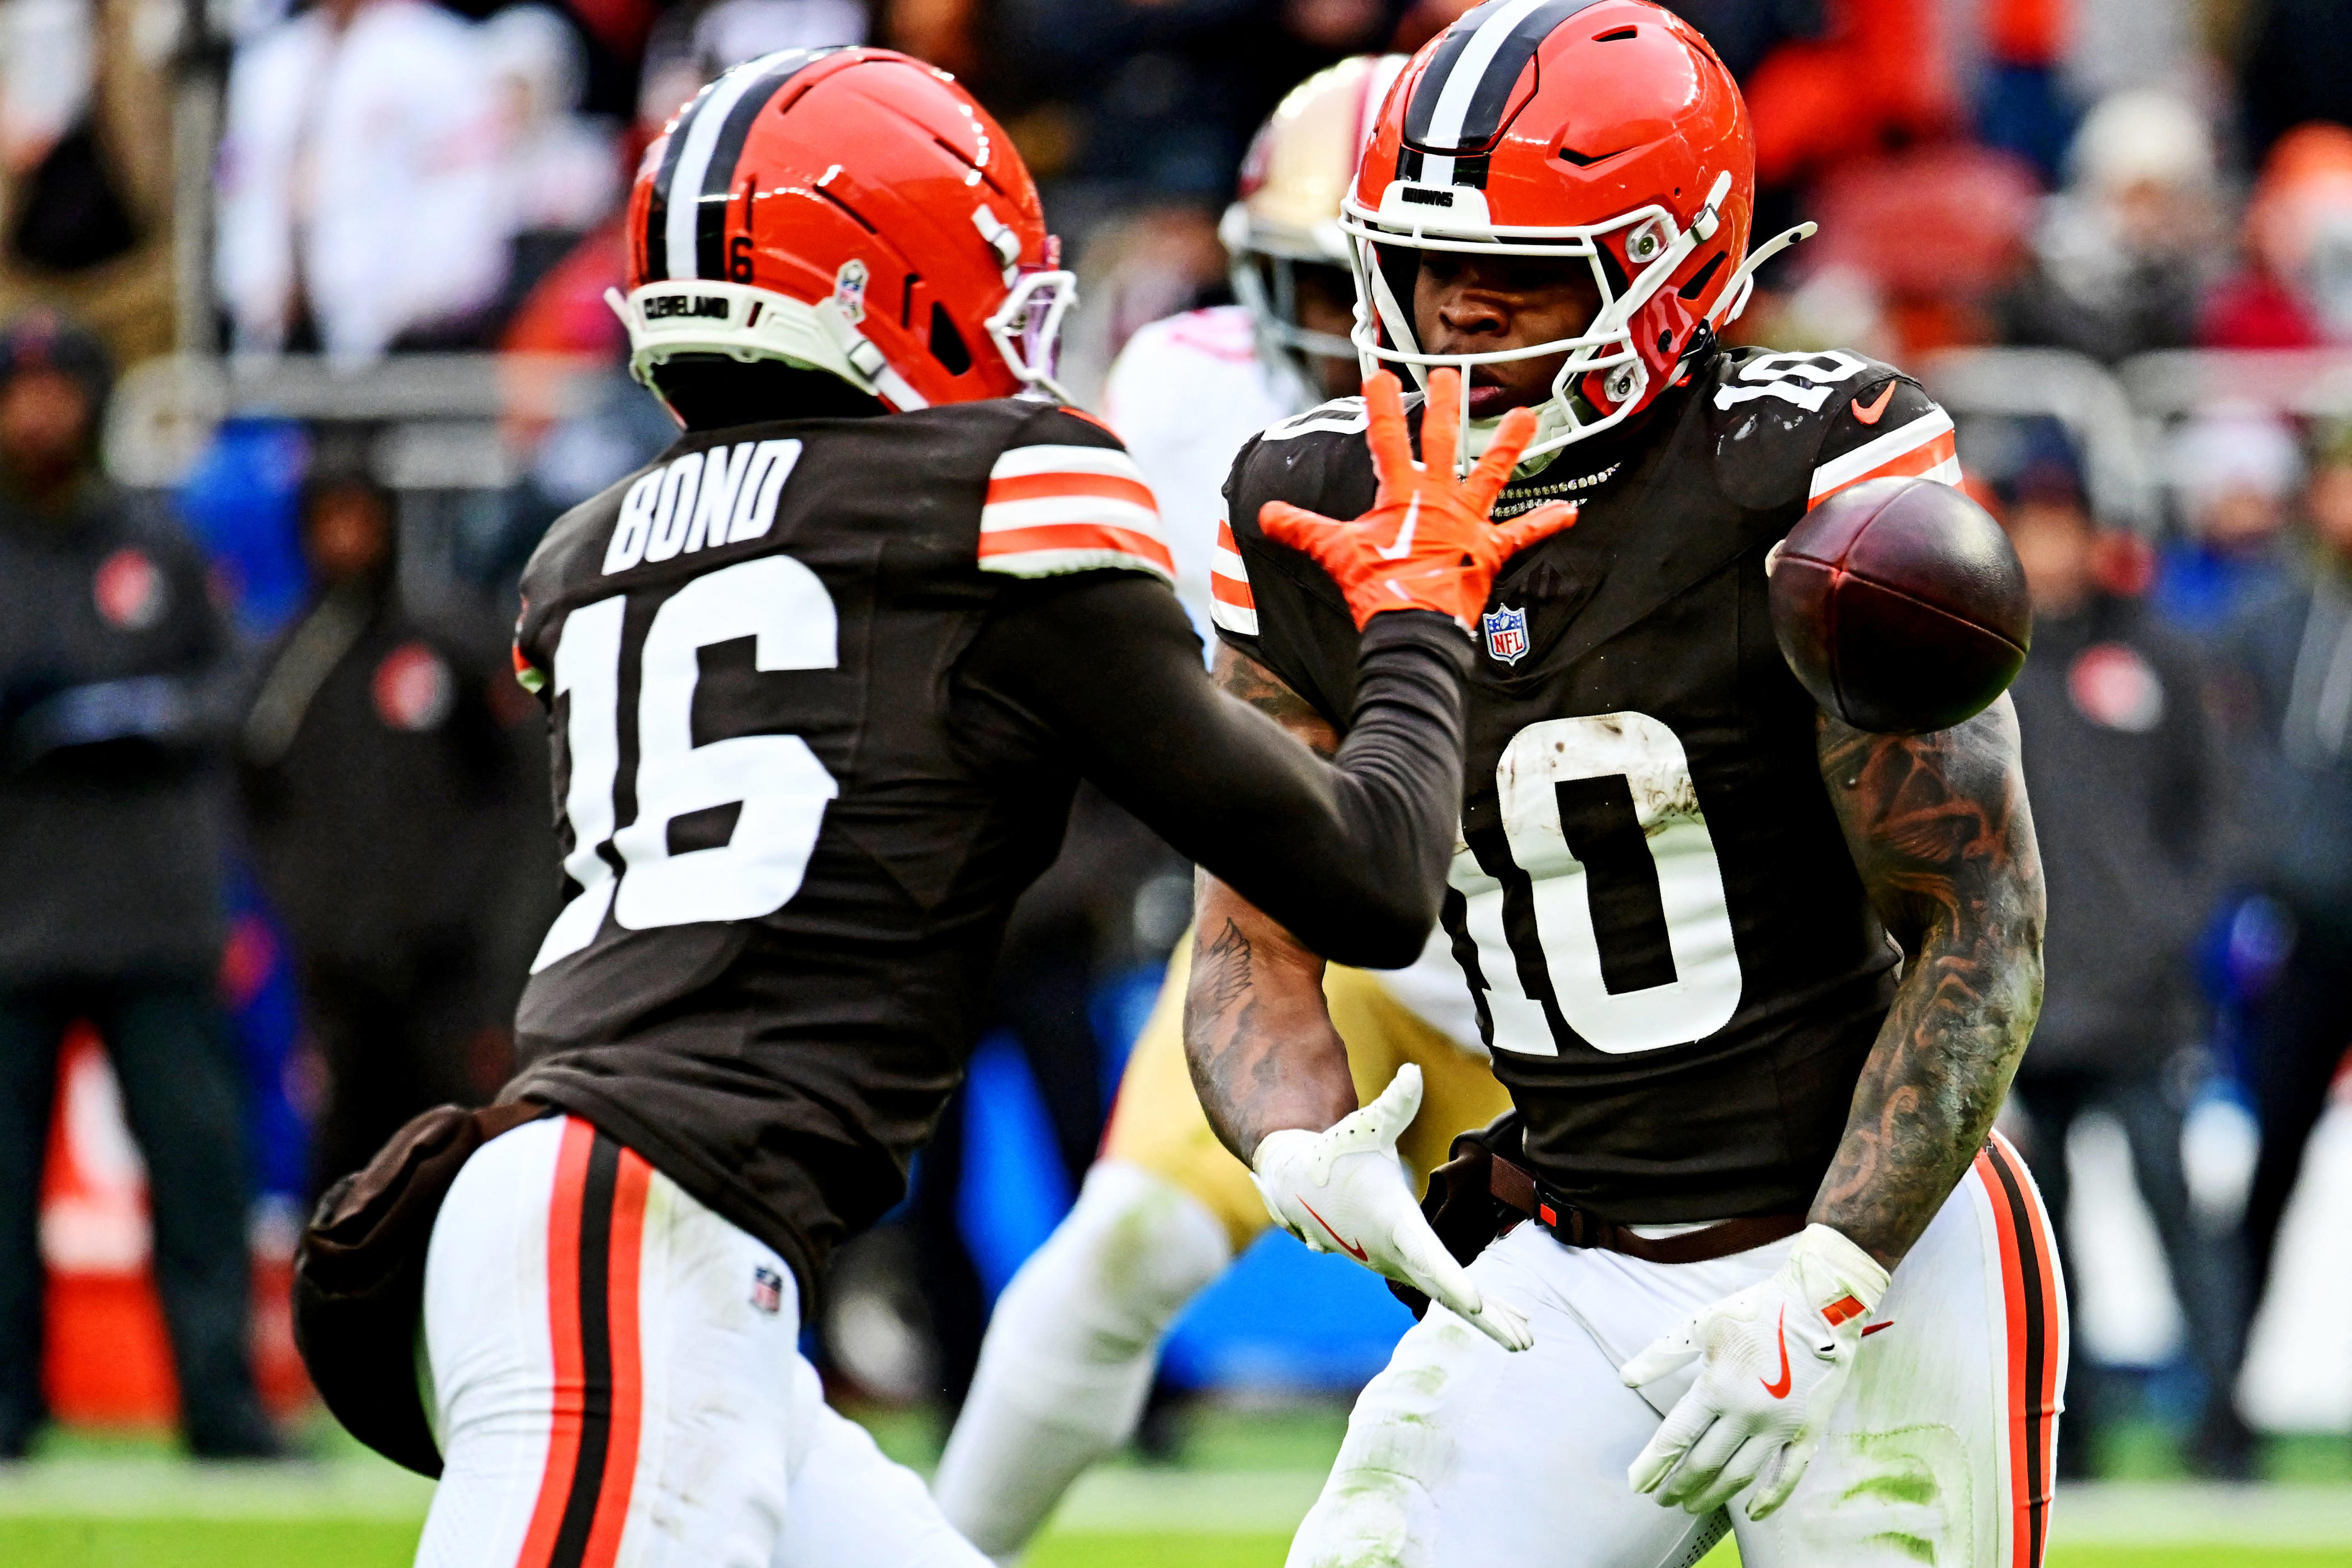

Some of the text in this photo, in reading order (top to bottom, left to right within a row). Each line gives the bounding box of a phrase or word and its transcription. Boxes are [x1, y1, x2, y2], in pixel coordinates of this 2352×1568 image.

[1714, 350, 1867, 413] 10
[602, 438, 802, 576] BOND
[1493, 632, 1523, 654] NFL
[529, 555, 839, 975] 16
[1448, 710, 1743, 1057] 10
